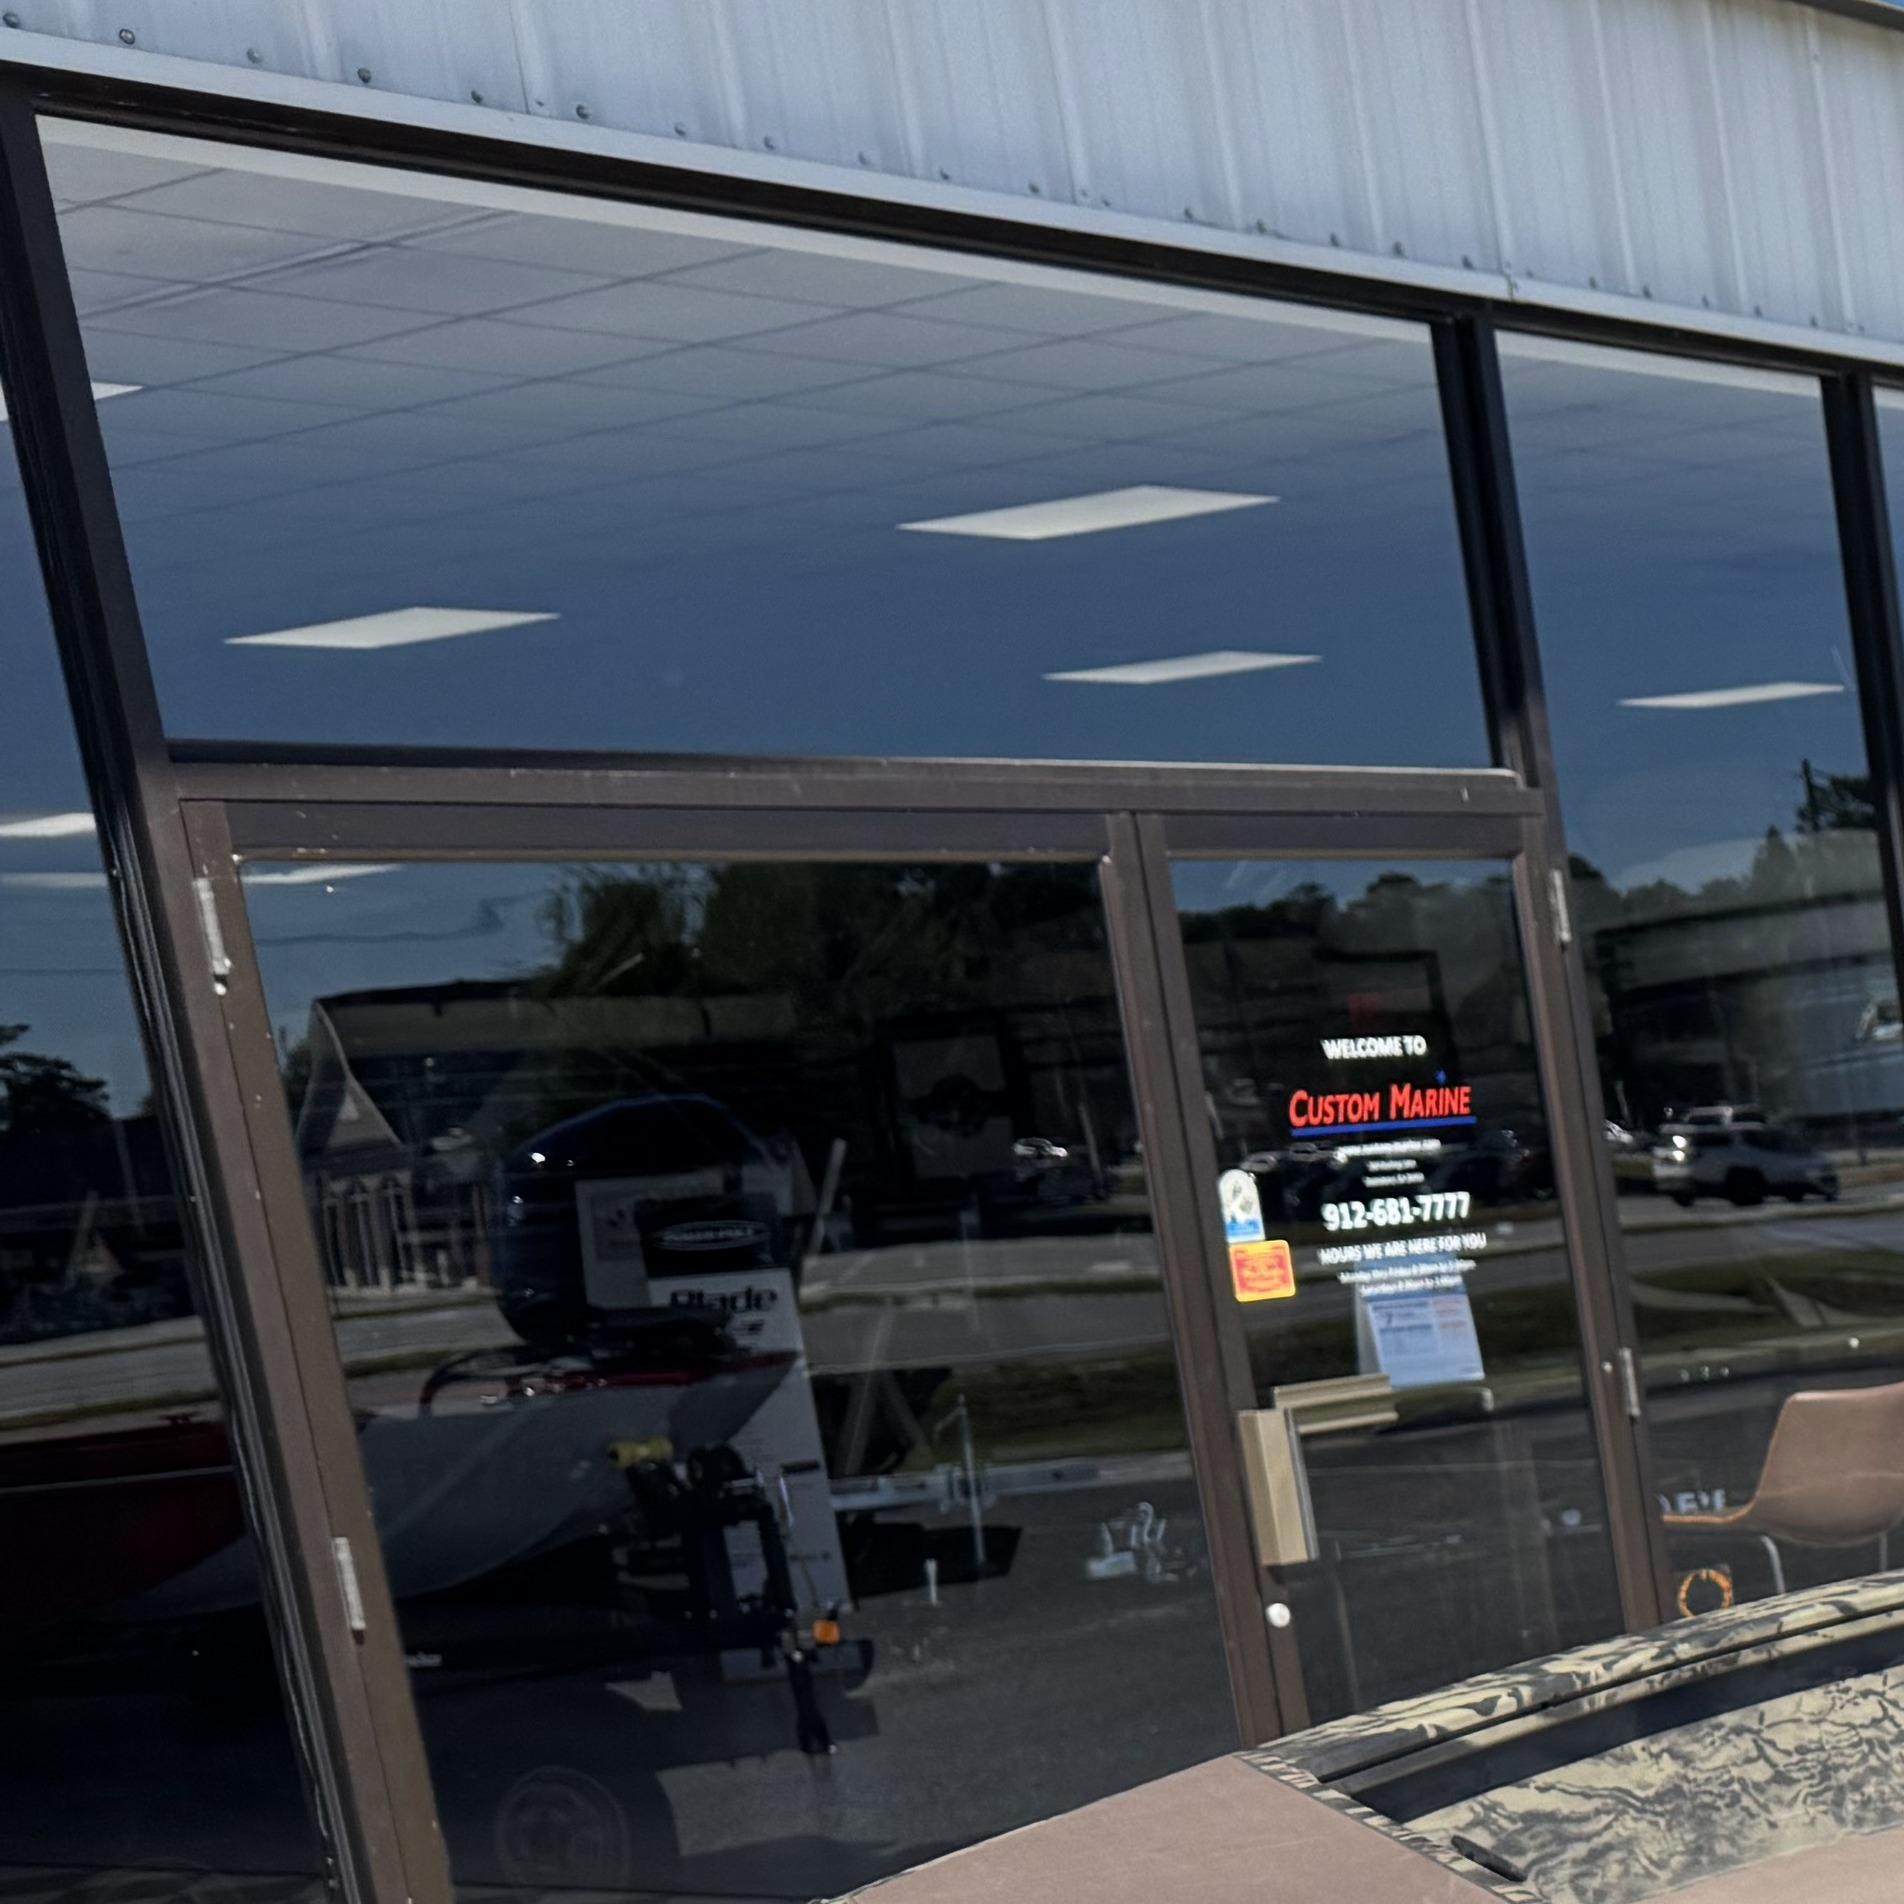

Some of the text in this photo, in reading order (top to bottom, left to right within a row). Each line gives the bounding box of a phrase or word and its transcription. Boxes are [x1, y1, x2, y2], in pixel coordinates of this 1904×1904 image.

[1320, 1034, 1428, 1060] WELCOME TO
[1289, 1082, 1472, 1128] CUSTOM MARINE
[1321, 1191, 1471, 1232] 912-681-7777
[1318, 1231, 1488, 1265] HOURS WE ARE HERE FOR YOU
